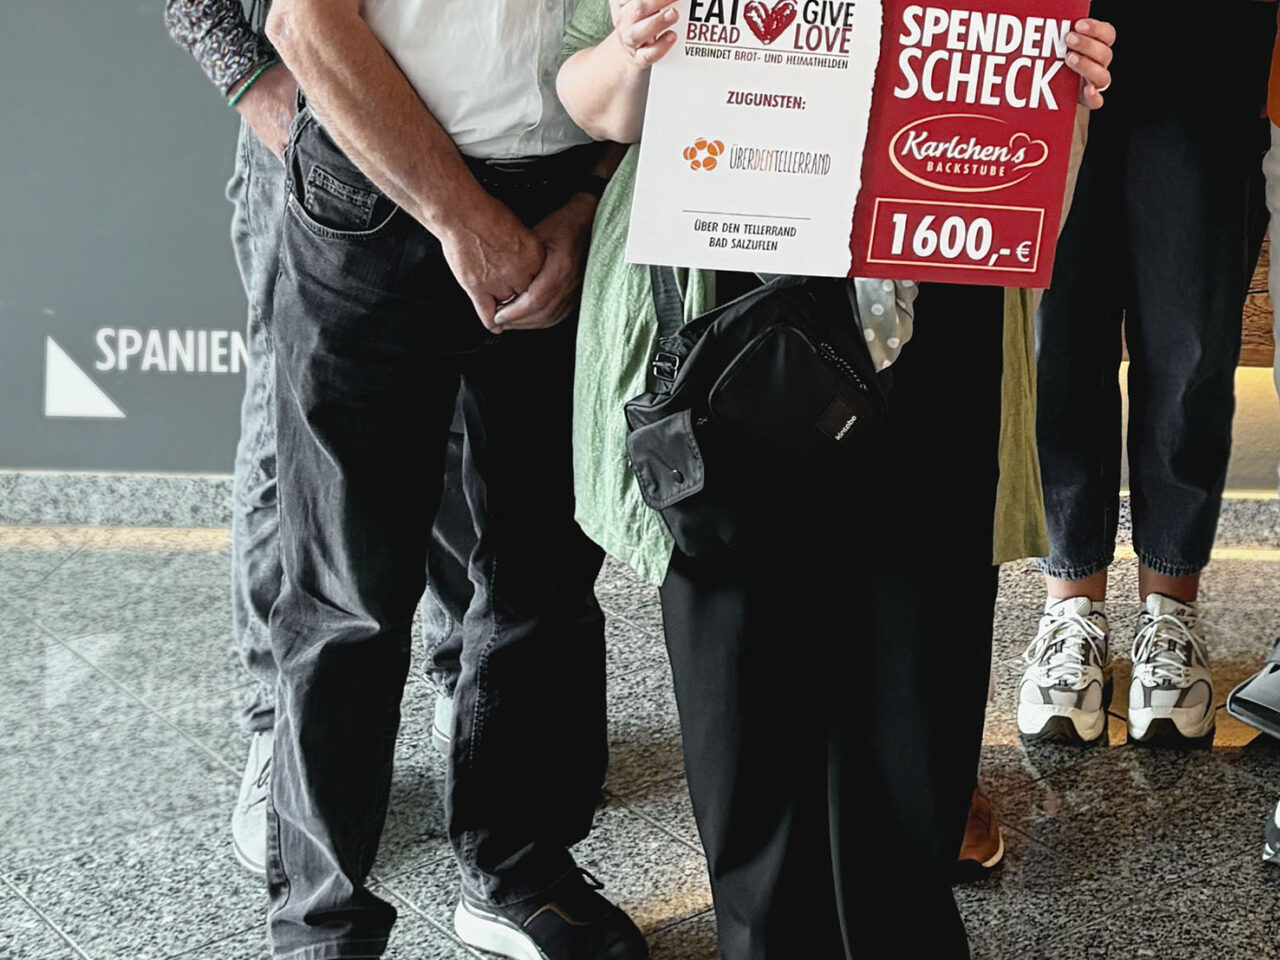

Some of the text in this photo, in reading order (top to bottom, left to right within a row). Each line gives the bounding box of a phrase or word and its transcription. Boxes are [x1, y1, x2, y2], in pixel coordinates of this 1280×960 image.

[686, 22, 853, 54] BREAD LOVE
[898, 4, 1072, 59] SPENDEN
[685, 46, 849, 69] VERBINDET BROT- UND HEIMATHELDEN
[893, 47, 1066, 111] SCHECK
[726, 90, 807, 110] ZUGUNSTEN:
[926, 161, 1006, 177] BACKSTUBE
[694, 218, 797, 237] ÜBER DEN TELLERRAND
[709, 237, 778, 251] BAD SALZUFLEN
